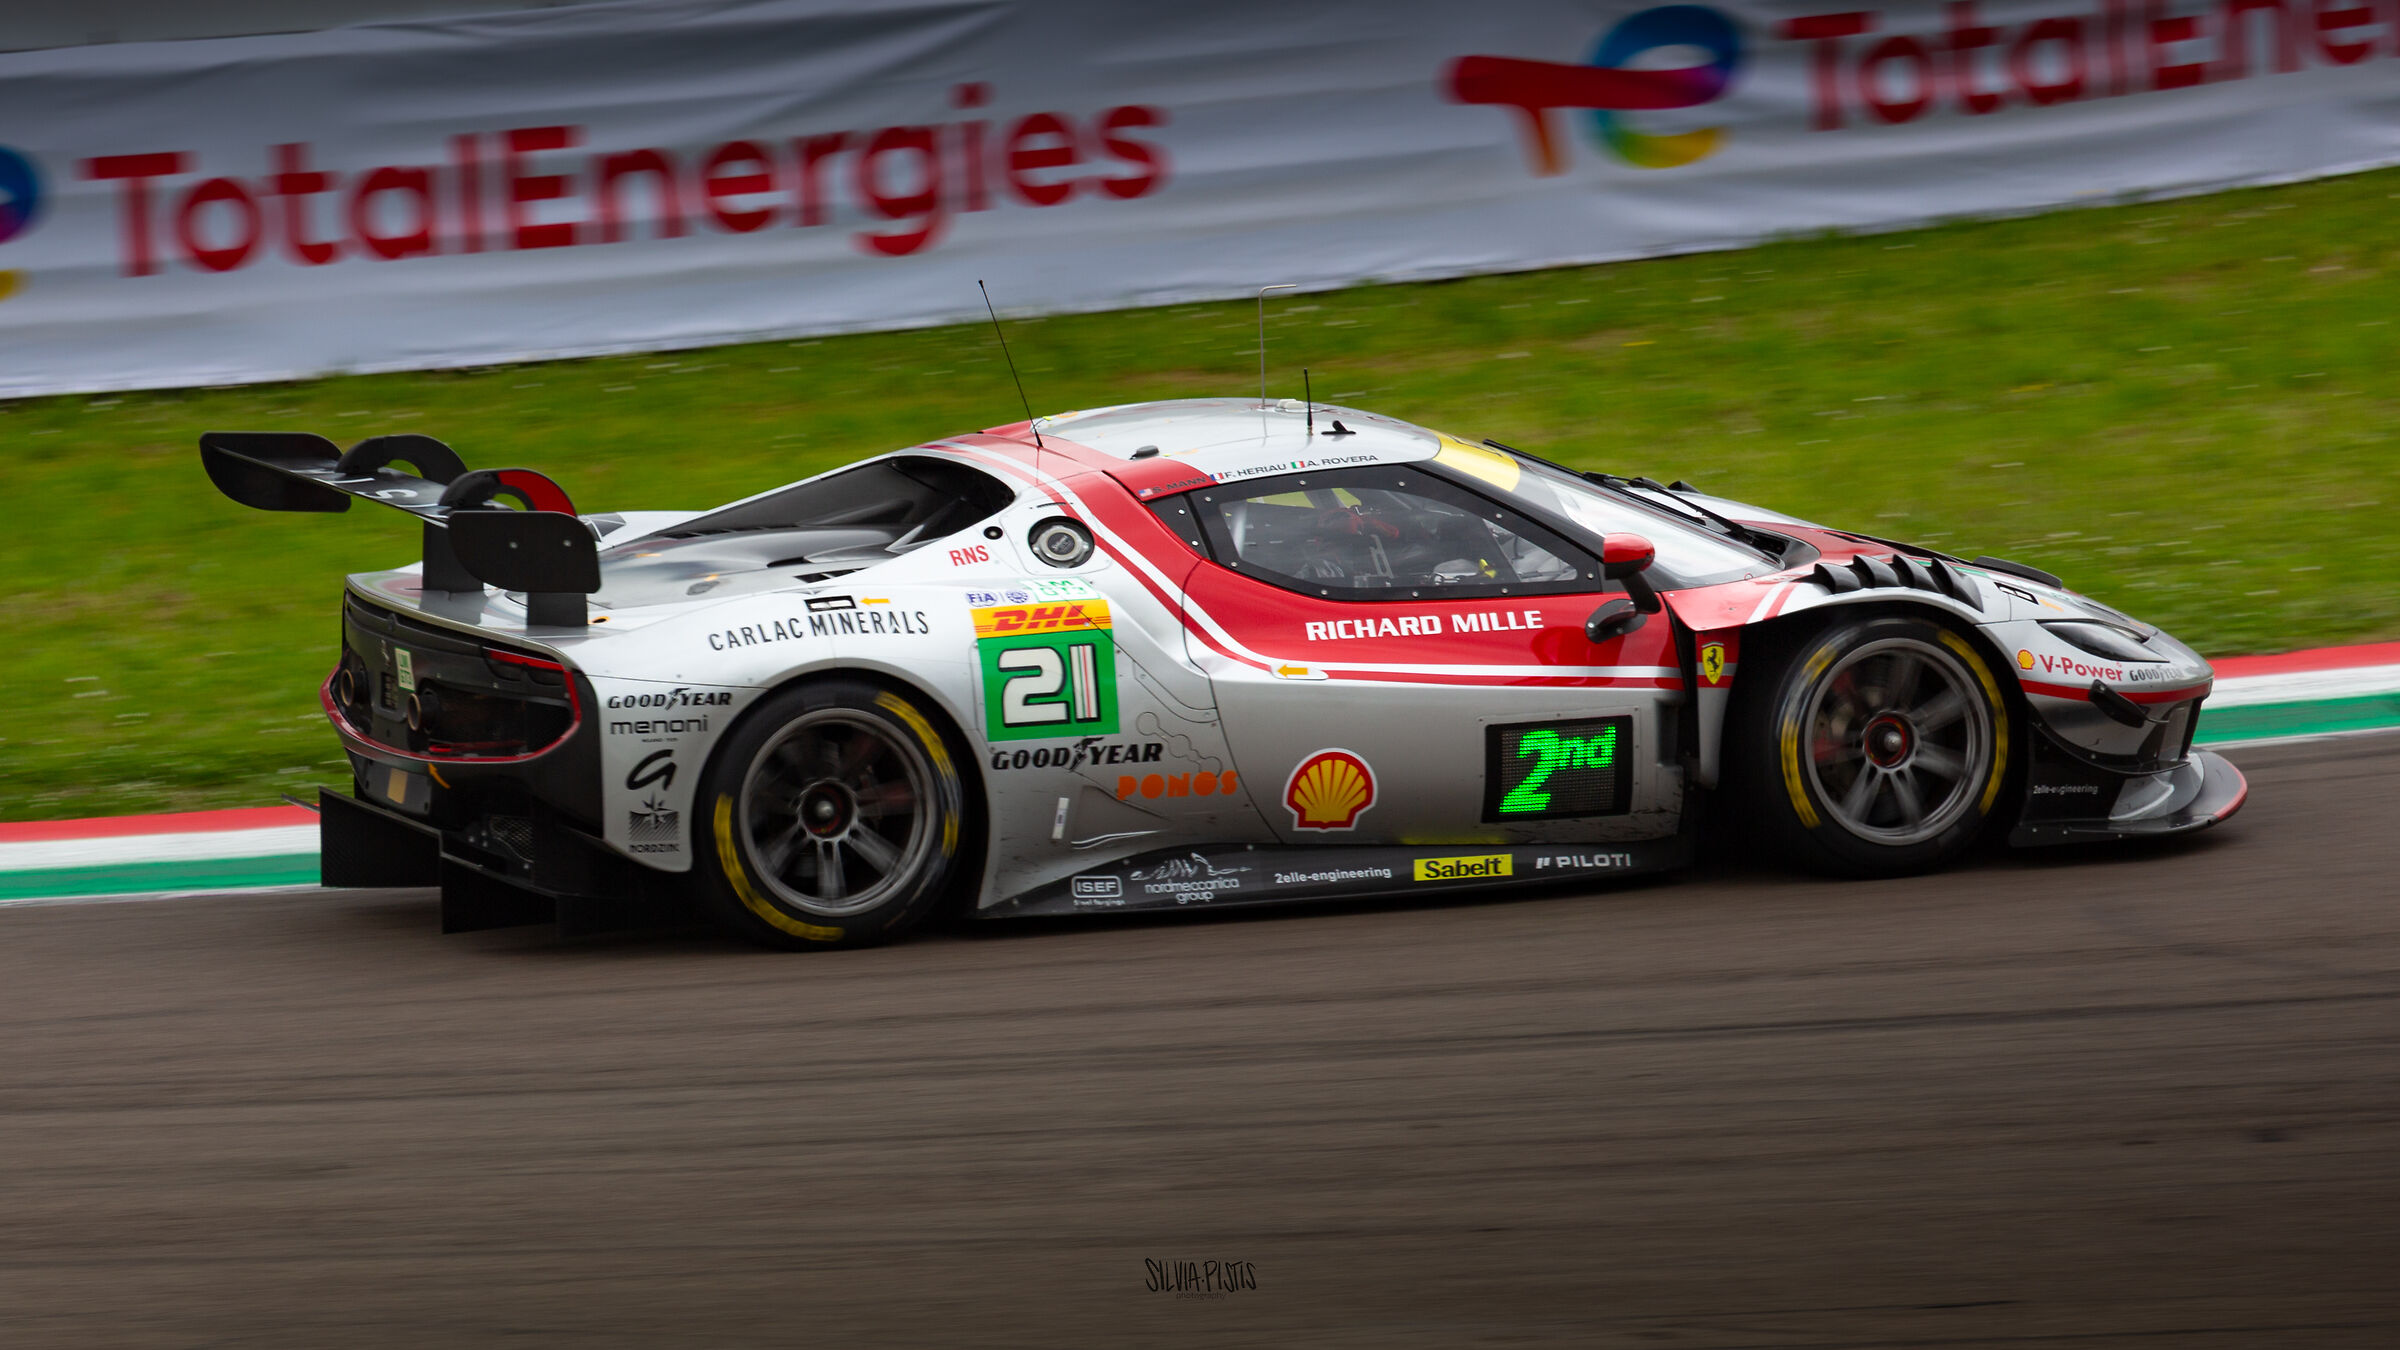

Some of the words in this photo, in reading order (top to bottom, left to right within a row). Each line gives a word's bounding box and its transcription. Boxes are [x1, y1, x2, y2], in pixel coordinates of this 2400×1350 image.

[1777, 0, 2400, 131] TotalEne
[78, 81, 1172, 276] TotalEnergies
[1166, 476, 1207, 490] MANN
[1237, 464, 1287, 477] HERIAU
[1322, 454, 1379, 465] ROVERA
[949, 545, 990, 566] RNS
[708, 617, 804, 651] CARLAC
[808, 611, 930, 637] MINERALS
[992, 605, 1093, 631] DHL
[1306, 614, 1442, 641] RICHARD
[1452, 610, 1544, 634] MILLE
[2038, 654, 2123, 682] V-Power
[998, 641, 1102, 728] 21
[610, 714, 708, 735] menoni
[1499, 725, 1617, 813] 2nd
[1116, 770, 1239, 800] PONOS
[1424, 857, 1503, 880] Sabelt
[1556, 853, 1632, 869] PILOTI
[1076, 881, 1118, 893] ISEF
[1145, 876, 1240, 894] nordmeccanica
[1275, 866, 1392, 884] 2elle-engineering
[1175, 891, 1214, 905] group
